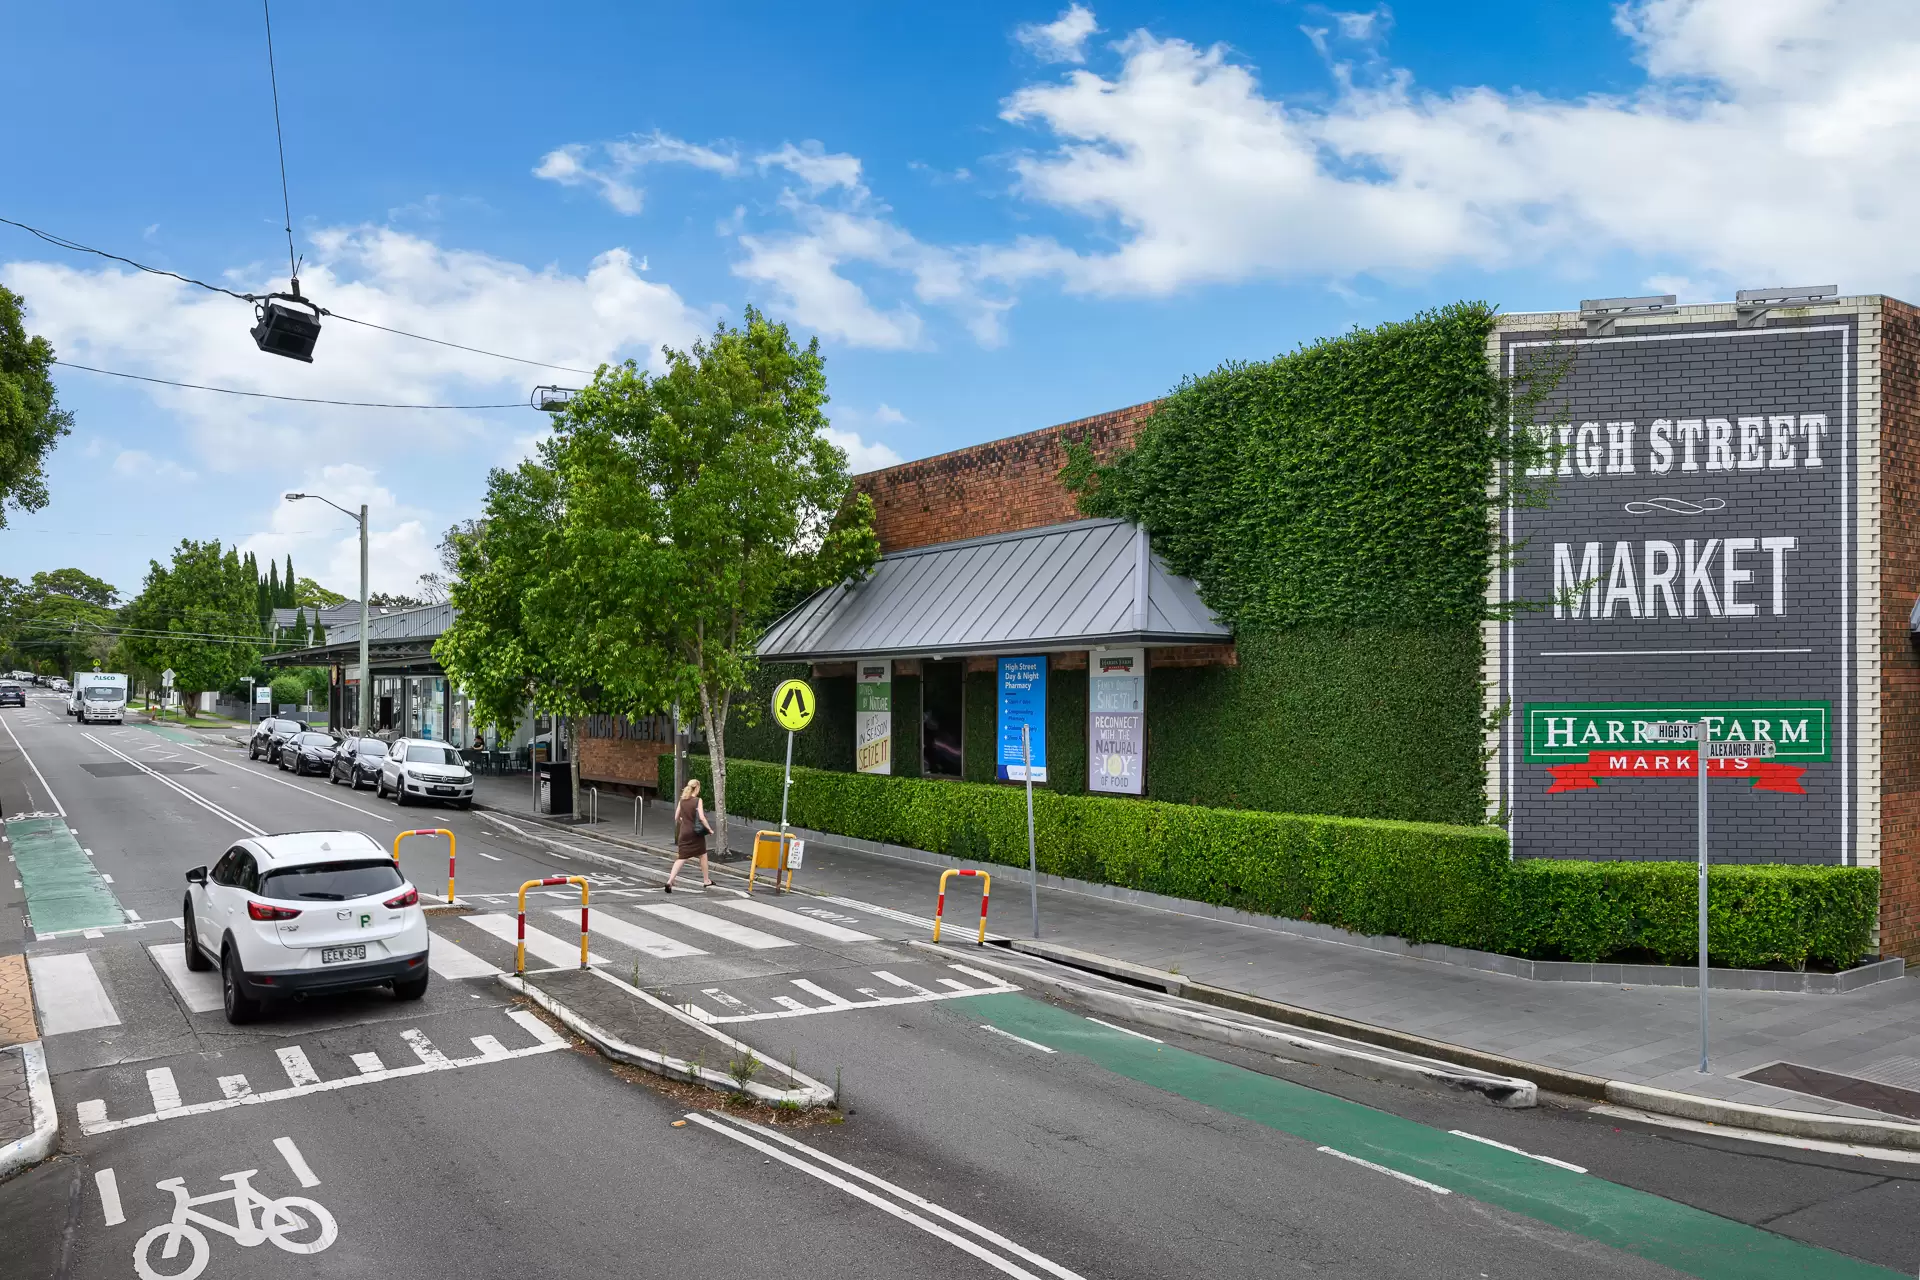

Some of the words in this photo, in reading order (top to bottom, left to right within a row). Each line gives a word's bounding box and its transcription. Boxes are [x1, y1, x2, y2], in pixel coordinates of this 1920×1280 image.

[1649, 414, 1828, 476] STREET
[1553, 537, 1798, 620] MARKET
[1005, 663, 1018, 672] High
[1019, 662, 1037, 670] Street
[1005, 672, 1016, 681] Day
[1017, 672, 1022, 680] &
[1023, 671, 1039, 681] Night
[1005, 681, 1032, 691] Pharmacy
[588, 713, 613, 738] HIGH
[1095, 716, 1139, 729] RECONNECT
[1100, 729, 1115, 740] WITH
[1118, 729, 1130, 740] THE
[1543, 716, 1689, 748] HARR
[1700, 716, 1809, 743] FARM
[1659, 725, 1680, 738] HIGH
[1682, 725, 1693, 738] ST
[881, 739, 888, 762] IT
[1095, 740, 1138, 754] NATURAL
[1710, 743, 1751, 757] ALEXANDER
[1753, 743, 1766, 756] AVE
[1100, 753, 1132, 776] JOY
[1609, 756, 1749, 769] MARKTS
[1101, 776, 1108, 786] OF
[1110, 776, 1129, 787] FOOD
[360, 914, 371, 928] P
